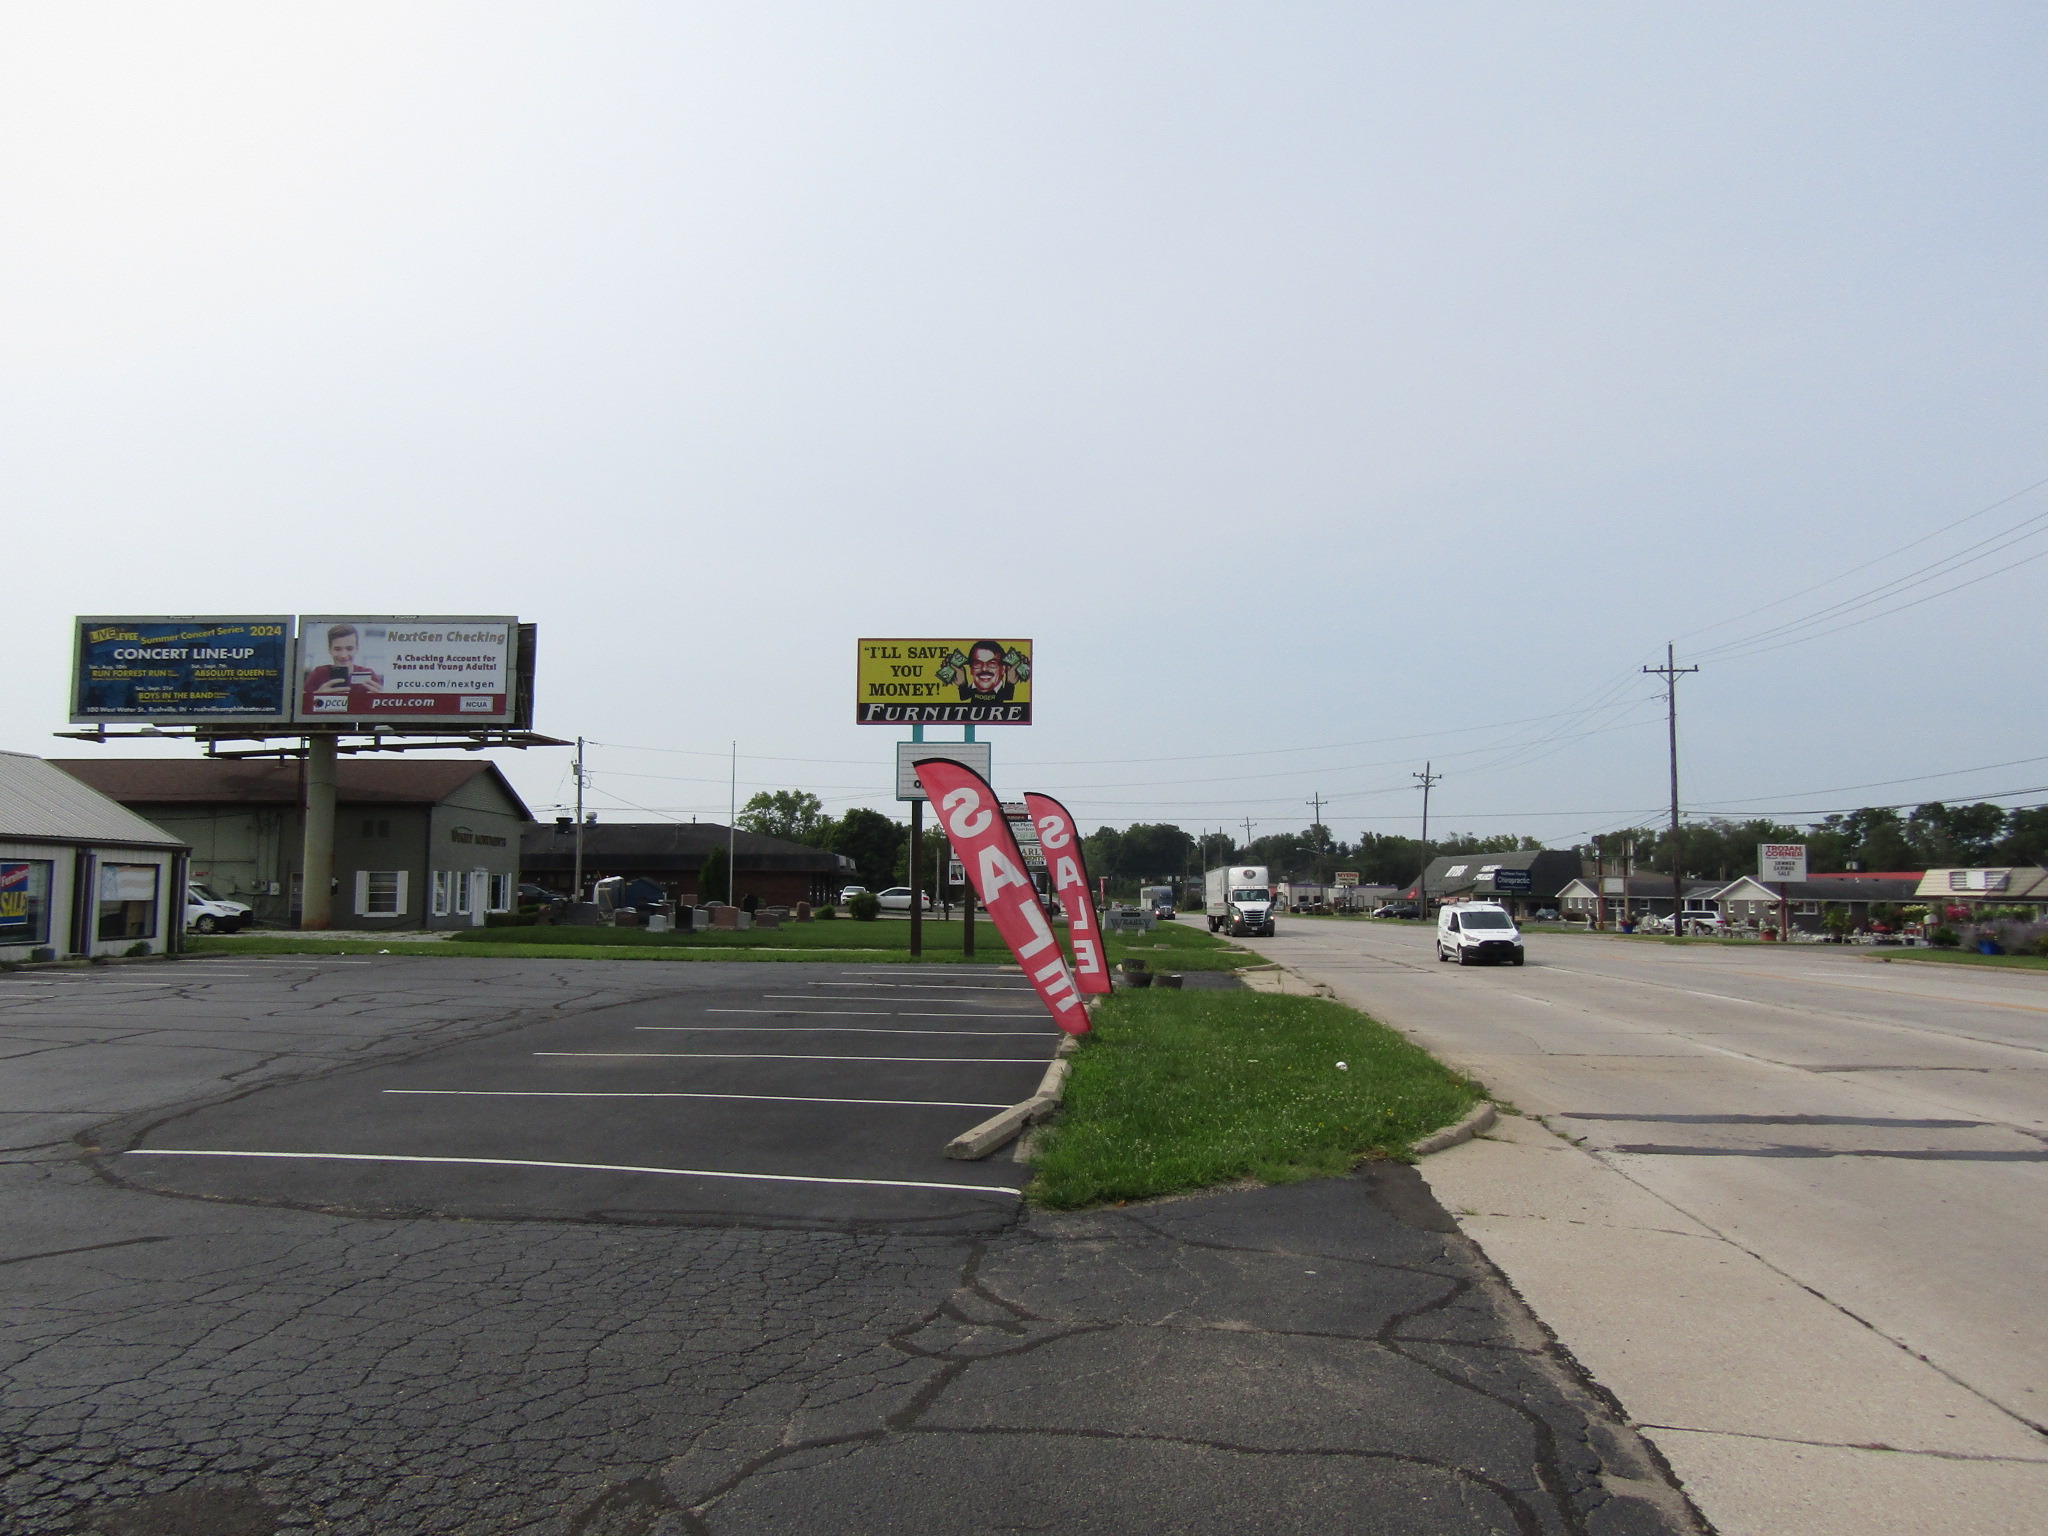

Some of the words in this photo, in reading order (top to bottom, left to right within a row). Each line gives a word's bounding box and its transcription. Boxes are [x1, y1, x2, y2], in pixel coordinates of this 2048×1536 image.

[90, 627, 116, 643] LIVE
[141, 634, 178, 645] Summer
[181, 629, 215, 639] Concert
[217, 626, 244, 635] Series
[250, 625, 282, 636] 2024
[388, 631, 443, 642] NextGen
[446, 631, 506, 645] Checking
[114, 648, 188, 660] CONCERT
[193, 648, 254, 660] LINE-UP
[404, 654, 444, 663] Checking
[447, 654, 481, 662] Account
[483, 654, 496, 662] for
[907, 646, 949, 659] SAVE
[92, 669, 110, 677] RUN
[112, 669, 147, 677] FORREST
[148, 669, 167, 677] RUN
[438, 663, 463, 671] Young
[466, 663, 497, 671] Adults!
[890, 665, 923, 677] YOU
[397, 679, 495, 689] pccu.com/nextgen
[324, 698, 348, 709] pccu
[371, 697, 435, 709] pccu.com
[865, 703, 1022, 721] FURNITURE
[1497, 876, 1530, 885] Chiropractic
